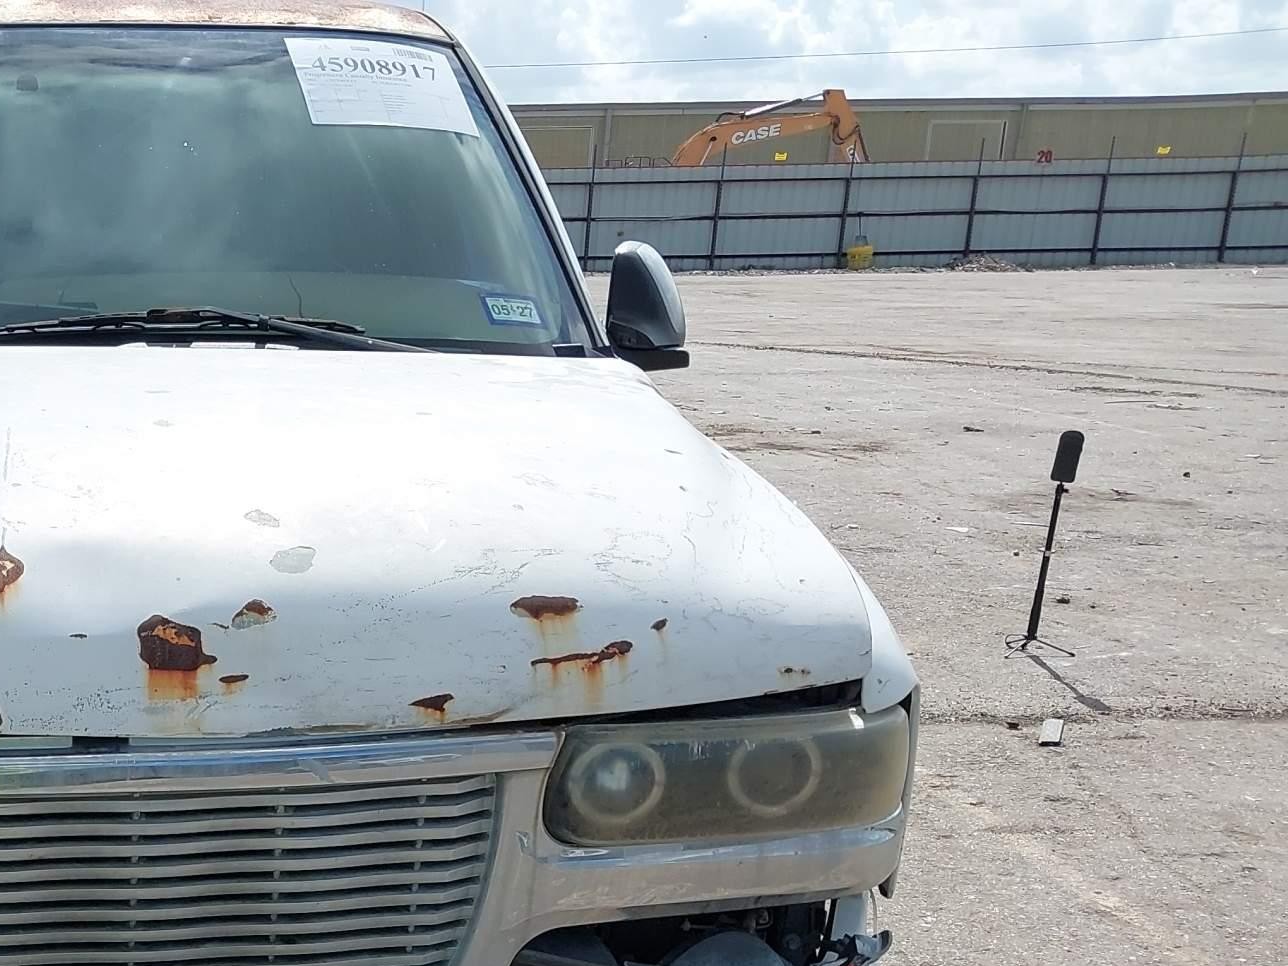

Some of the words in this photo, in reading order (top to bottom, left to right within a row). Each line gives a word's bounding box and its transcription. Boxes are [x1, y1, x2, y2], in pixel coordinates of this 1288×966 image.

[312, 56, 435, 81] 45908917
[731, 123, 781, 145] CASE
[1037, 150, 1052, 163] 20
[491, 304, 510, 316] 05
